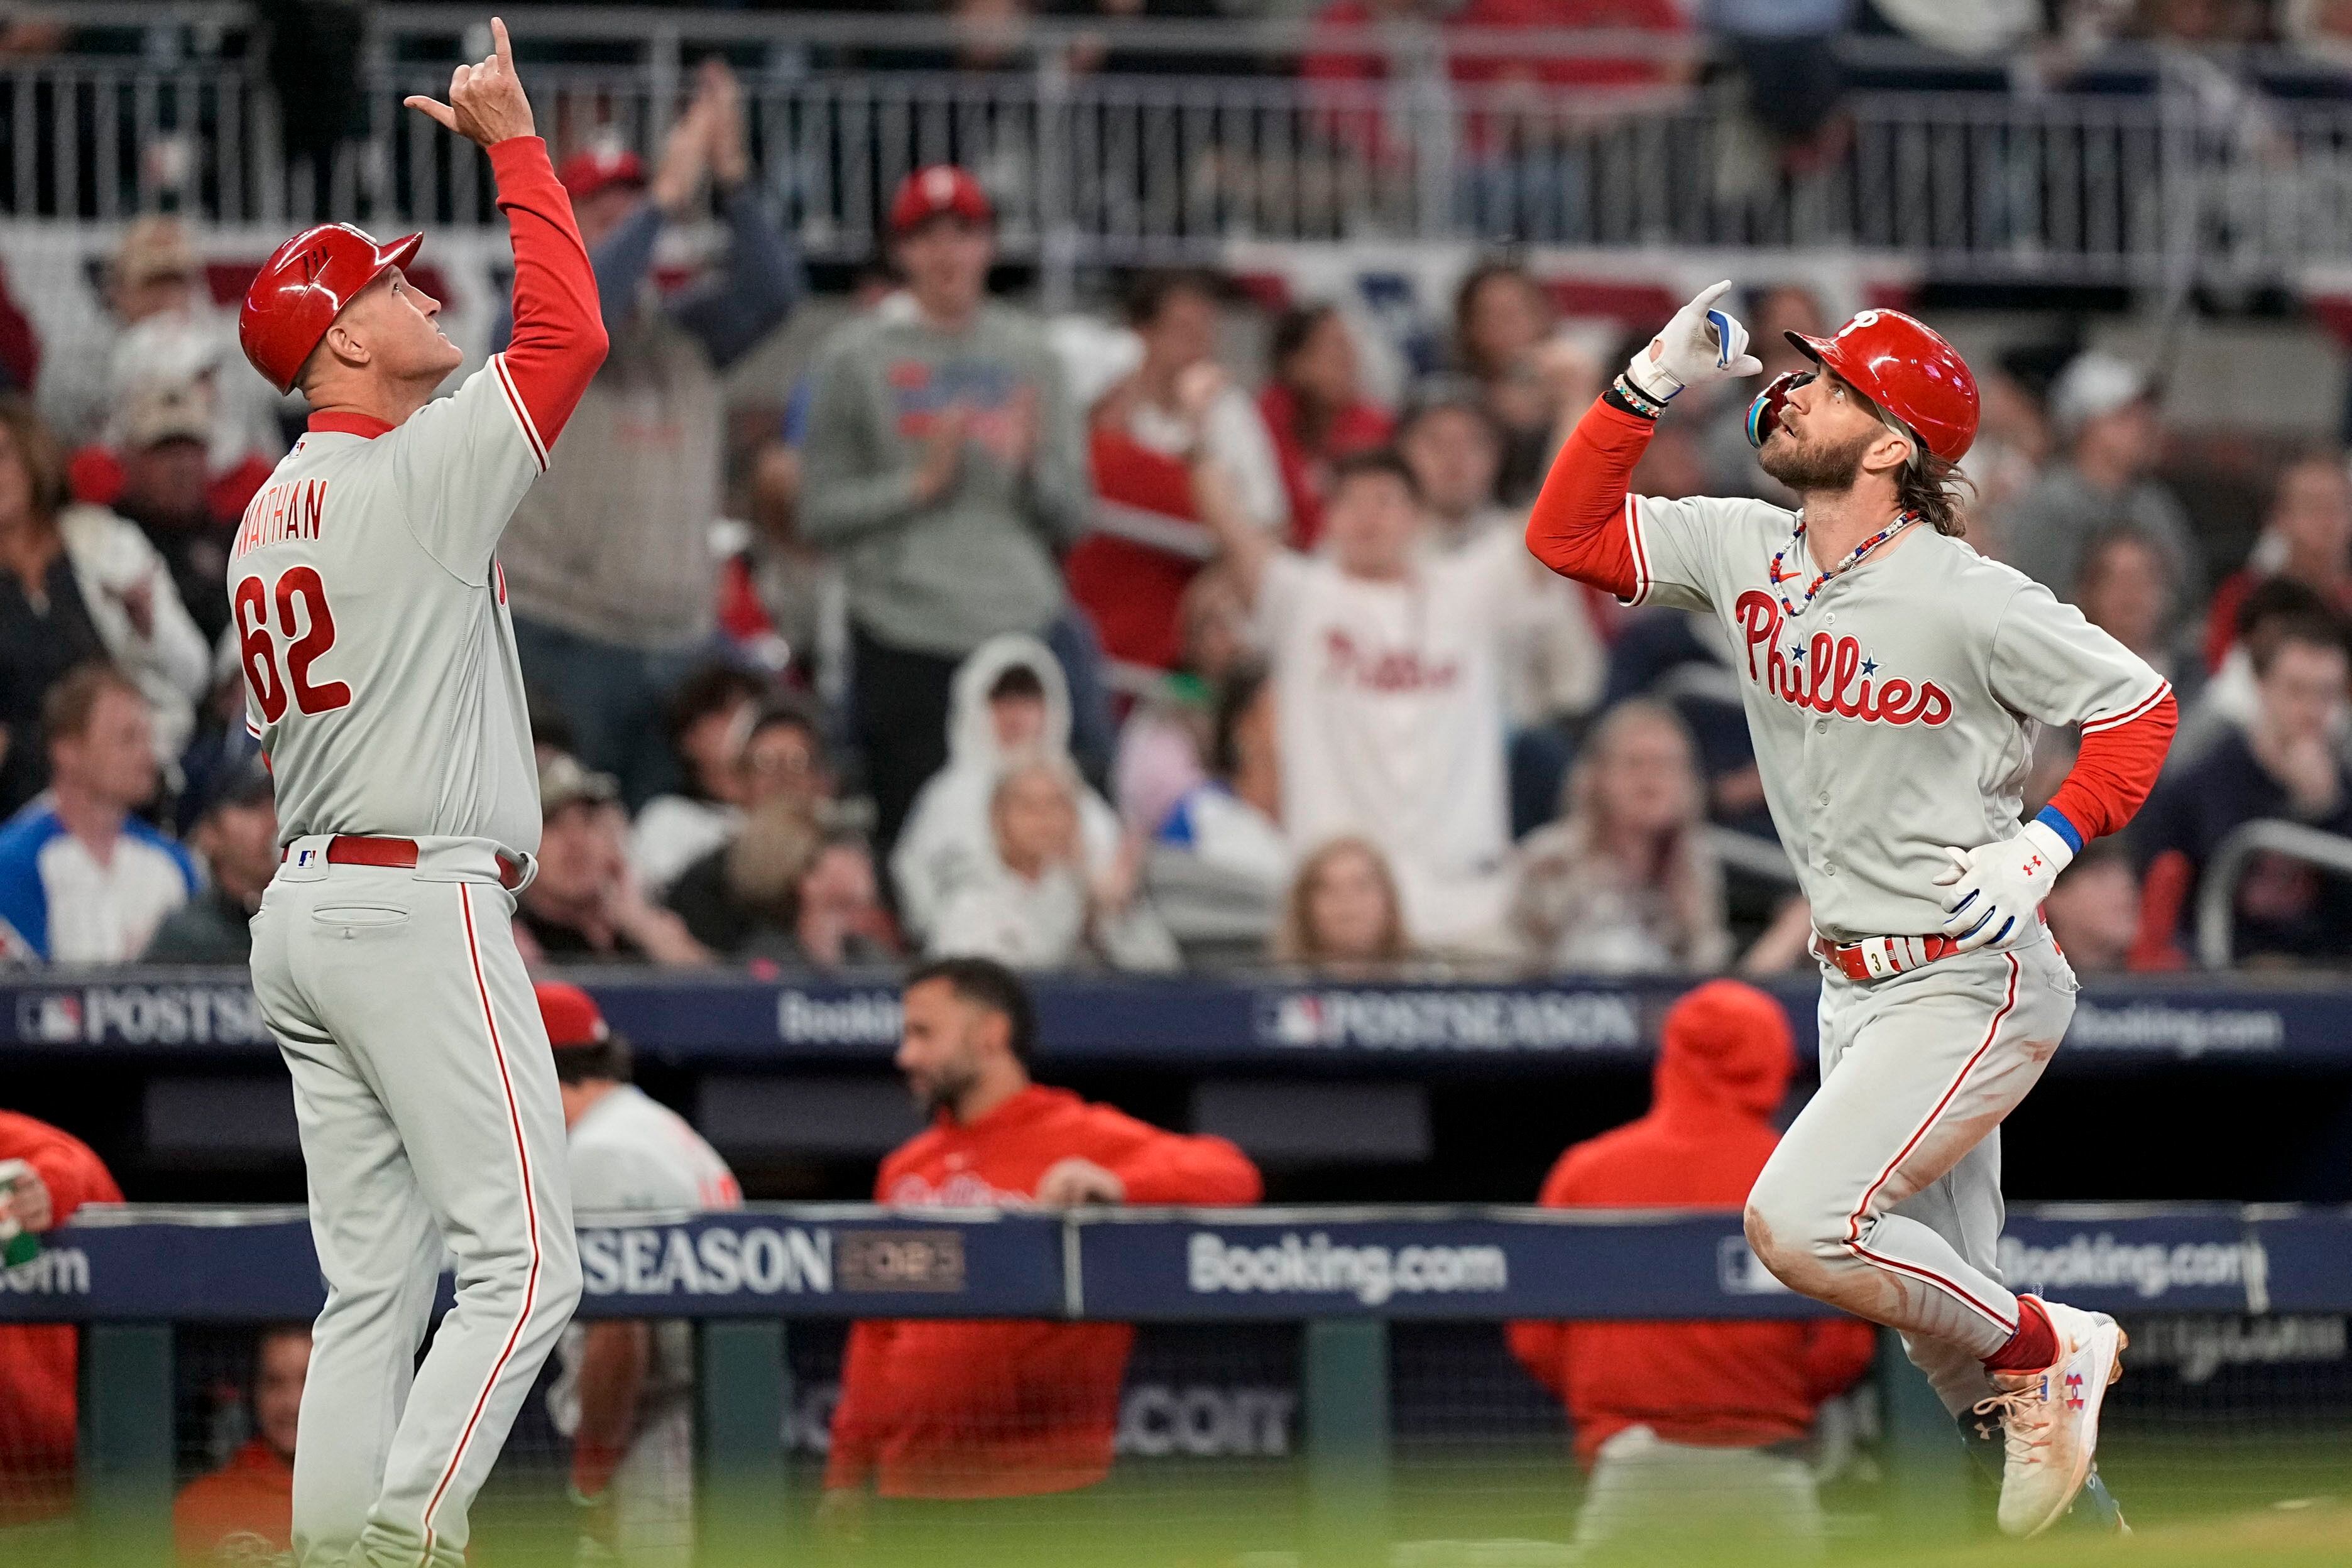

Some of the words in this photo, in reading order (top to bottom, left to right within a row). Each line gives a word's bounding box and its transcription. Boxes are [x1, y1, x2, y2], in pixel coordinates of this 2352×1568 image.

[1839, 310, 1878, 337] P
[236, 478, 328, 563] NATHAN
[234, 564, 353, 726] 62
[1734, 589, 1954, 729] Phillies
[1871, 952, 1882, 972] 3
[84, 988, 269, 1047] POSTS
[1188, 1233, 1506, 1305] Booking.com
